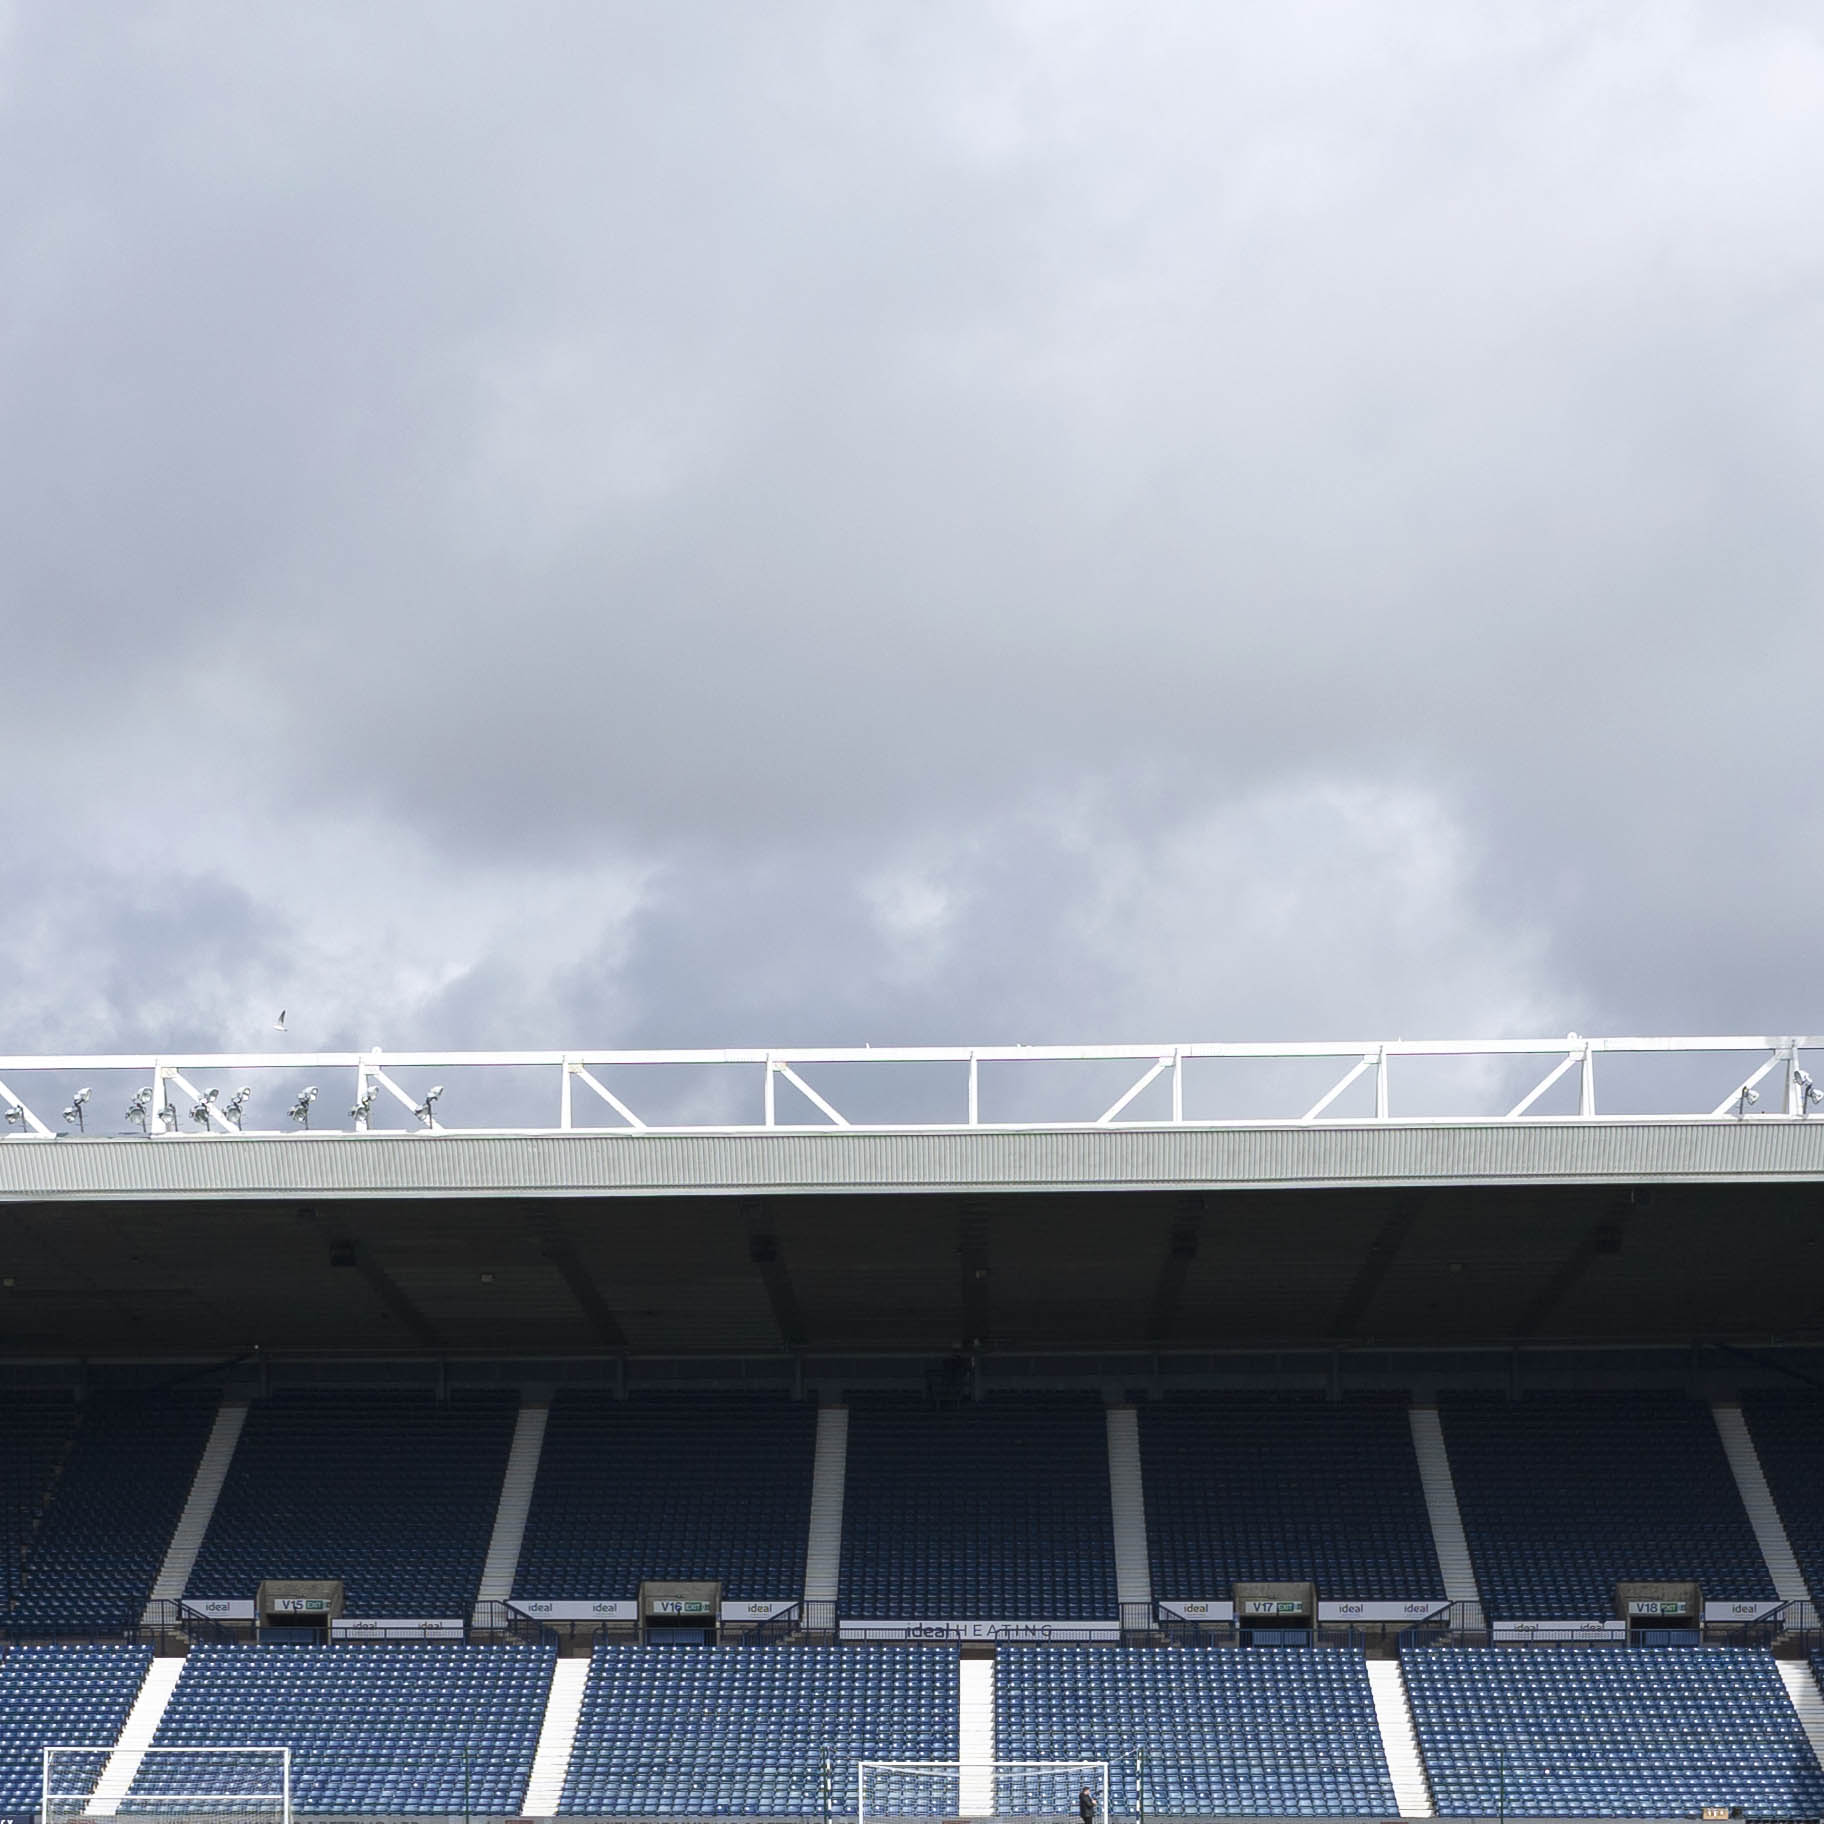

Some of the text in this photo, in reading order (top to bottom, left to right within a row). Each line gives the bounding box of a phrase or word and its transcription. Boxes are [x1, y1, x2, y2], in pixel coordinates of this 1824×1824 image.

[205, 1602, 231, 1611] ideal
[282, 1599, 304, 1609] V15
[528, 1603, 553, 1612] ideal
[592, 1603, 617, 1612] ideal
[661, 1602, 682, 1612] V16
[747, 1603, 773, 1613] ideal
[1183, 1603, 1209, 1613] ideal
[1253, 1602, 1273, 1612] V17
[1339, 1603, 1364, 1613] ideal
[1404, 1603, 1429, 1613] ideal
[1636, 1603, 1658, 1613] V18
[1731, 1604, 1757, 1614] ideal
[906, 1622, 1053, 1638] ideal HEATING
